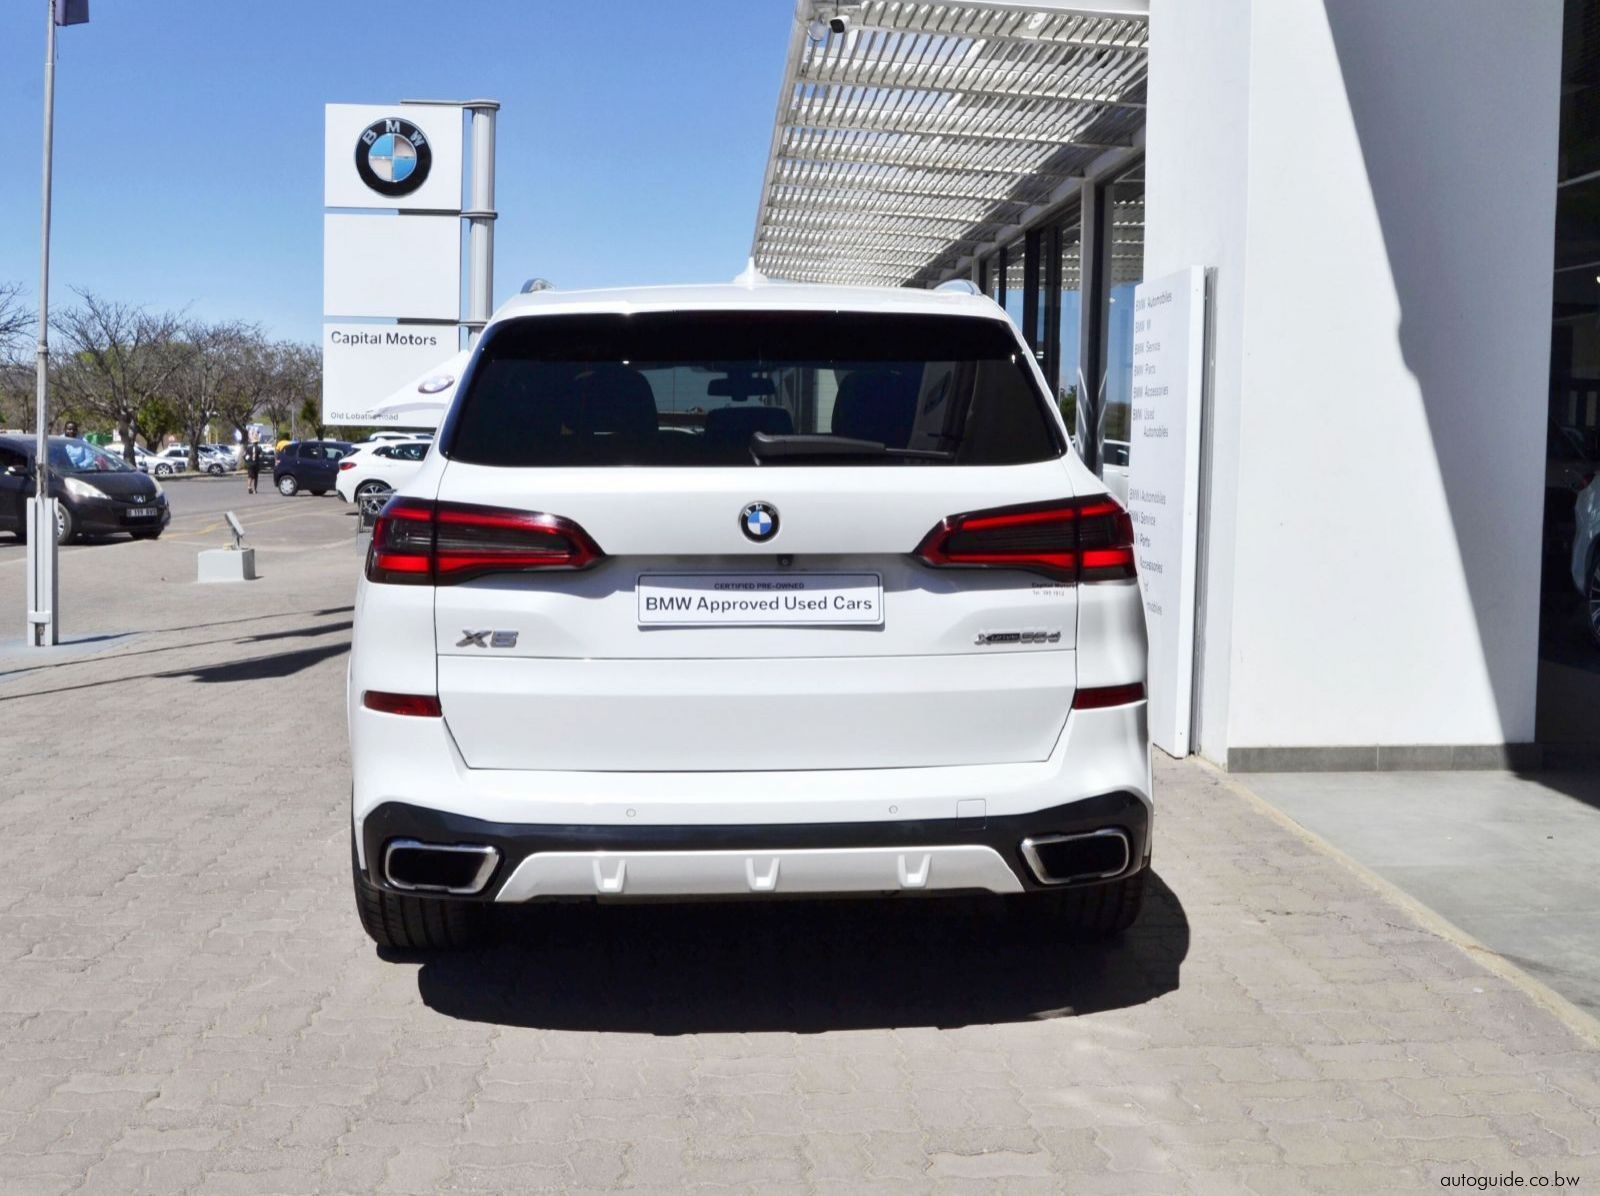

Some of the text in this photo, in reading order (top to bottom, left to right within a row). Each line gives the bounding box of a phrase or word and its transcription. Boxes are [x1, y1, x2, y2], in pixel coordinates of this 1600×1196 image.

[362, 119, 425, 147] BMW
[1135, 290, 1172, 312] BMW Automobiles
[1135, 320, 1145, 333] BMW
[331, 331, 437, 347] Capital Motors
[1134, 342, 1144, 355] BMW
[1133, 364, 1143, 377] BMW
[1133, 384, 1169, 399] BMW Accessories
[330, 411, 344, 420] Old
[1132, 408, 1142, 421] BMW
[1143, 424, 1169, 438] Automobiles
[645, 596, 873, 614] BMW Approved Used Cars
[456, 630, 519, 648] X5
